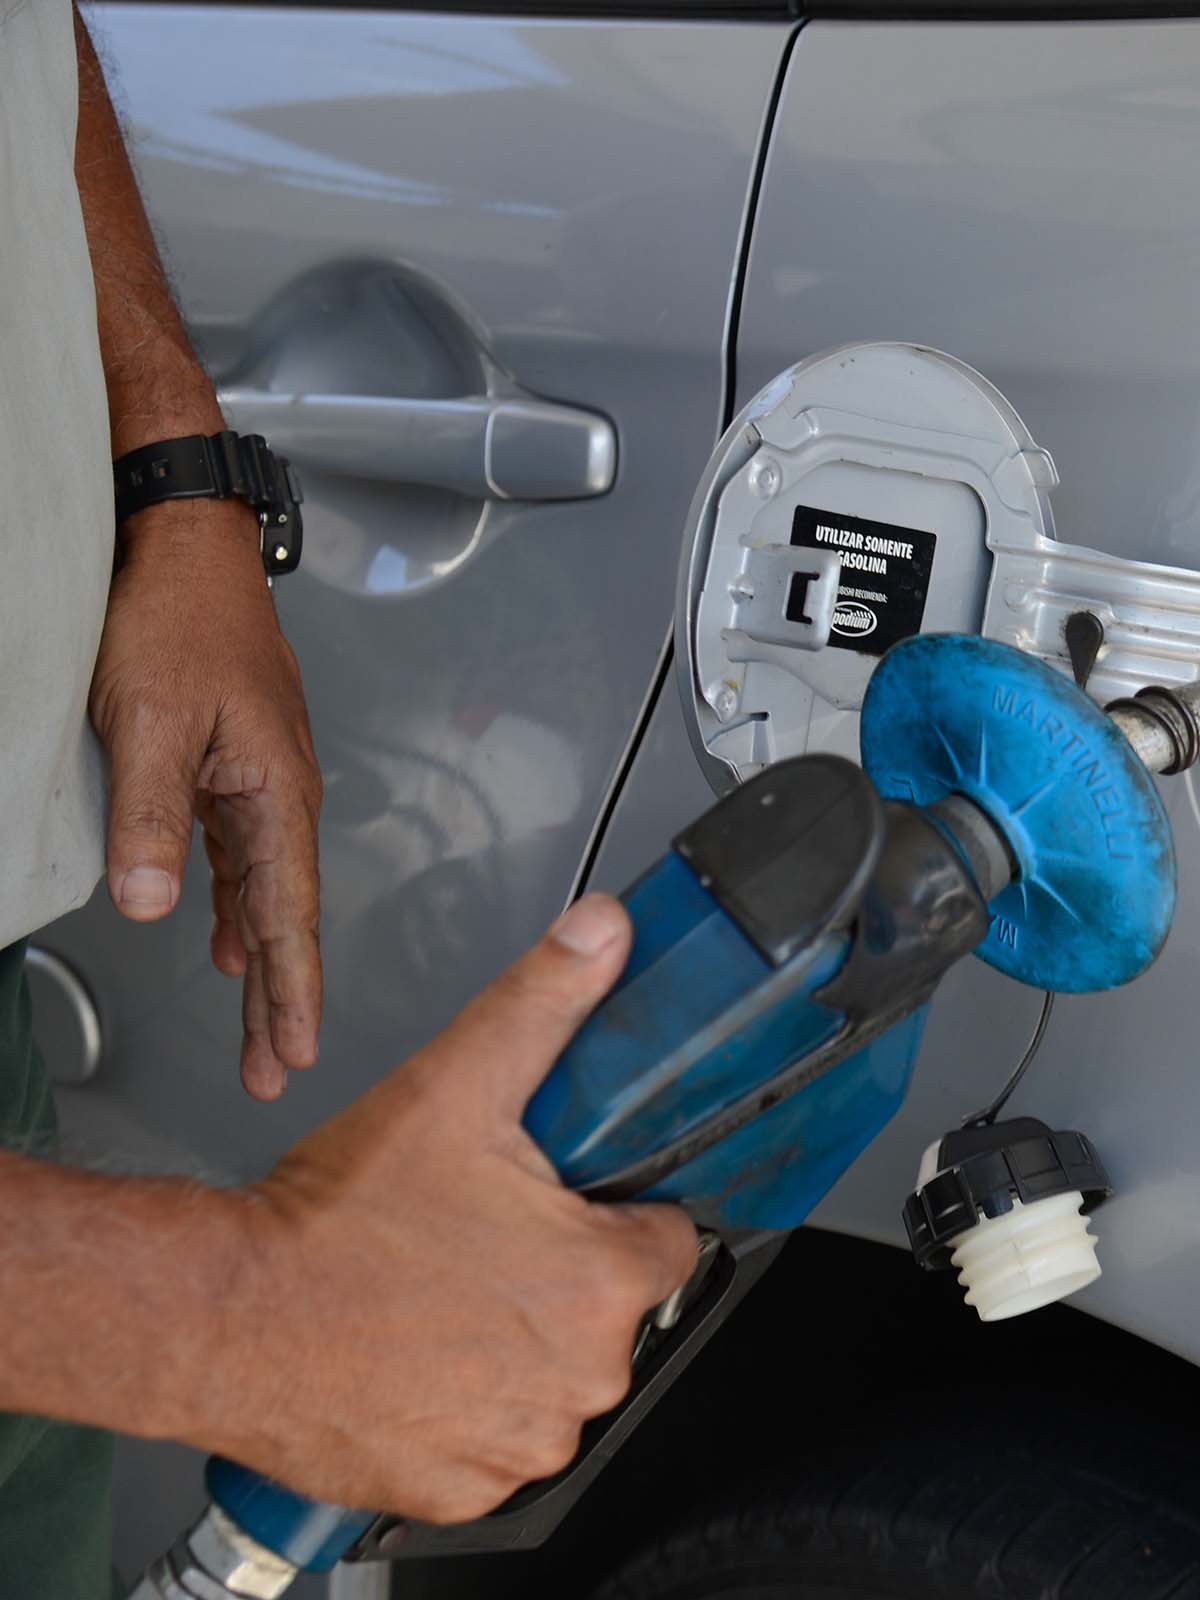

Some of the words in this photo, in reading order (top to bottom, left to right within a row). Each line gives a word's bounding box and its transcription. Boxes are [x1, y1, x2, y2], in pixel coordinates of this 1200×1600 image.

[815, 524, 864, 550] UTILIZAR
[864, 535, 914, 560] SOMENTE
[992, 687, 1134, 861] MARTINELLI
